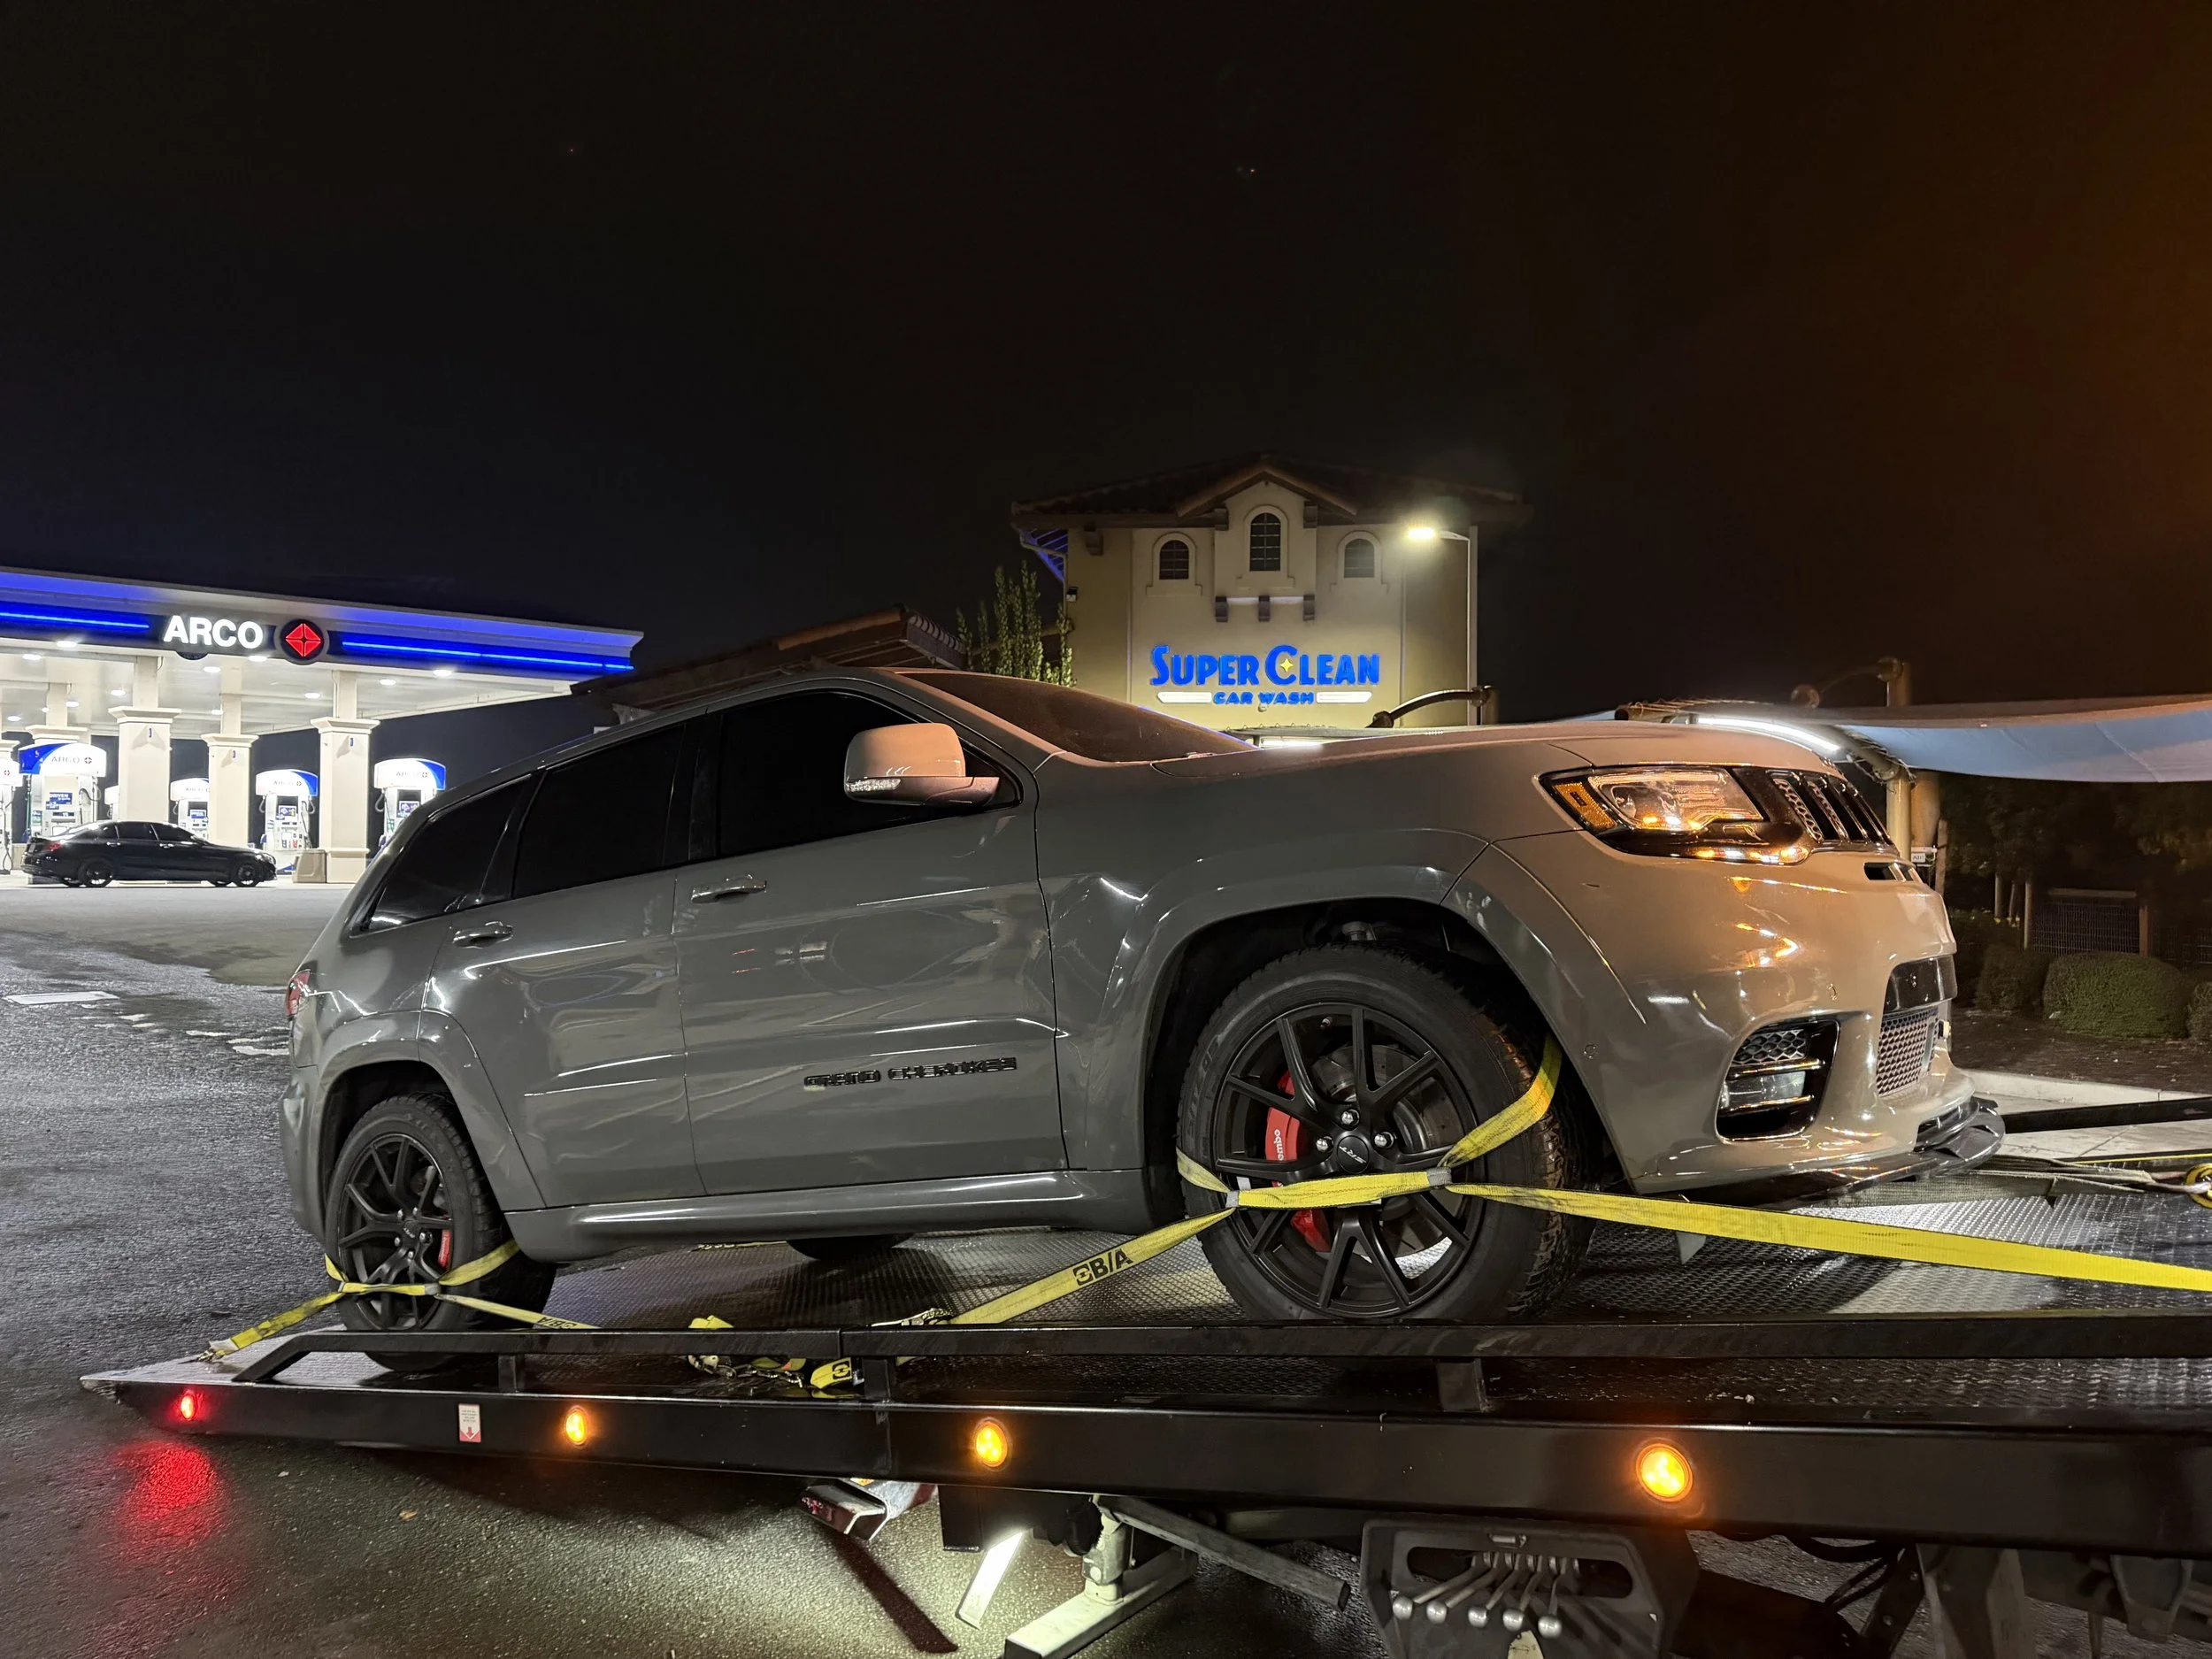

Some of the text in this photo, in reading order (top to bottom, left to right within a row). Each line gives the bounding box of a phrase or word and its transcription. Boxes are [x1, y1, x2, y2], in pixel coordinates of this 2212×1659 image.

[164, 615, 263, 649] ARCO
[1150, 644, 1379, 686] SUPER CLEAN
[1213, 691, 1314, 705] CAR WASH
